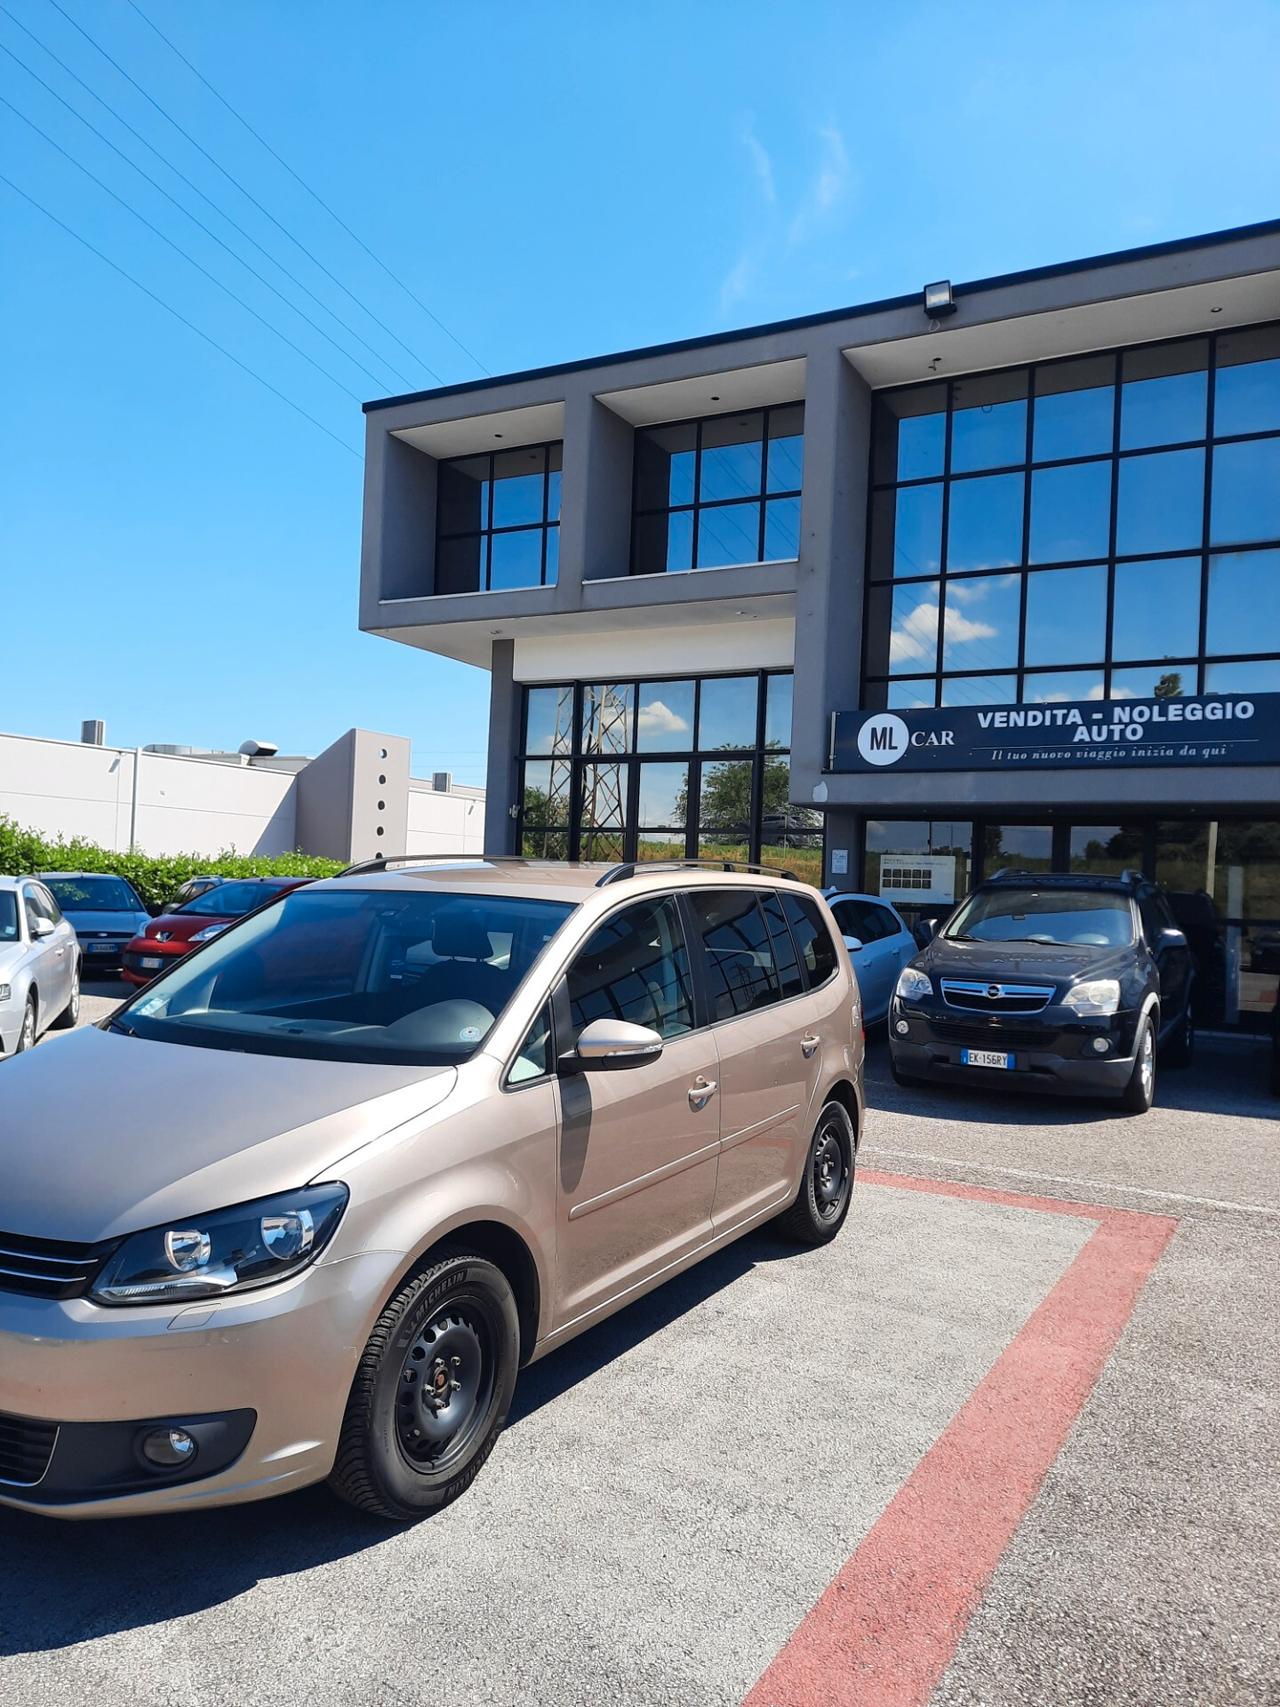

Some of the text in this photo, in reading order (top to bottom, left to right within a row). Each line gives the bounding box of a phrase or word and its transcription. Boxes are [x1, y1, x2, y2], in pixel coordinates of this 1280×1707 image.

[977, 708, 1083, 729] VENDITA
[1113, 701, 1255, 724] NOLEGGIO
[870, 726, 955, 751] ML CAR
[1073, 723, 1144, 742] AUTO
[992, 744, 1227, 761] Il tuo nuovo viaggio inizia da qui
[416, 1271, 464, 1321] MICHELIN
